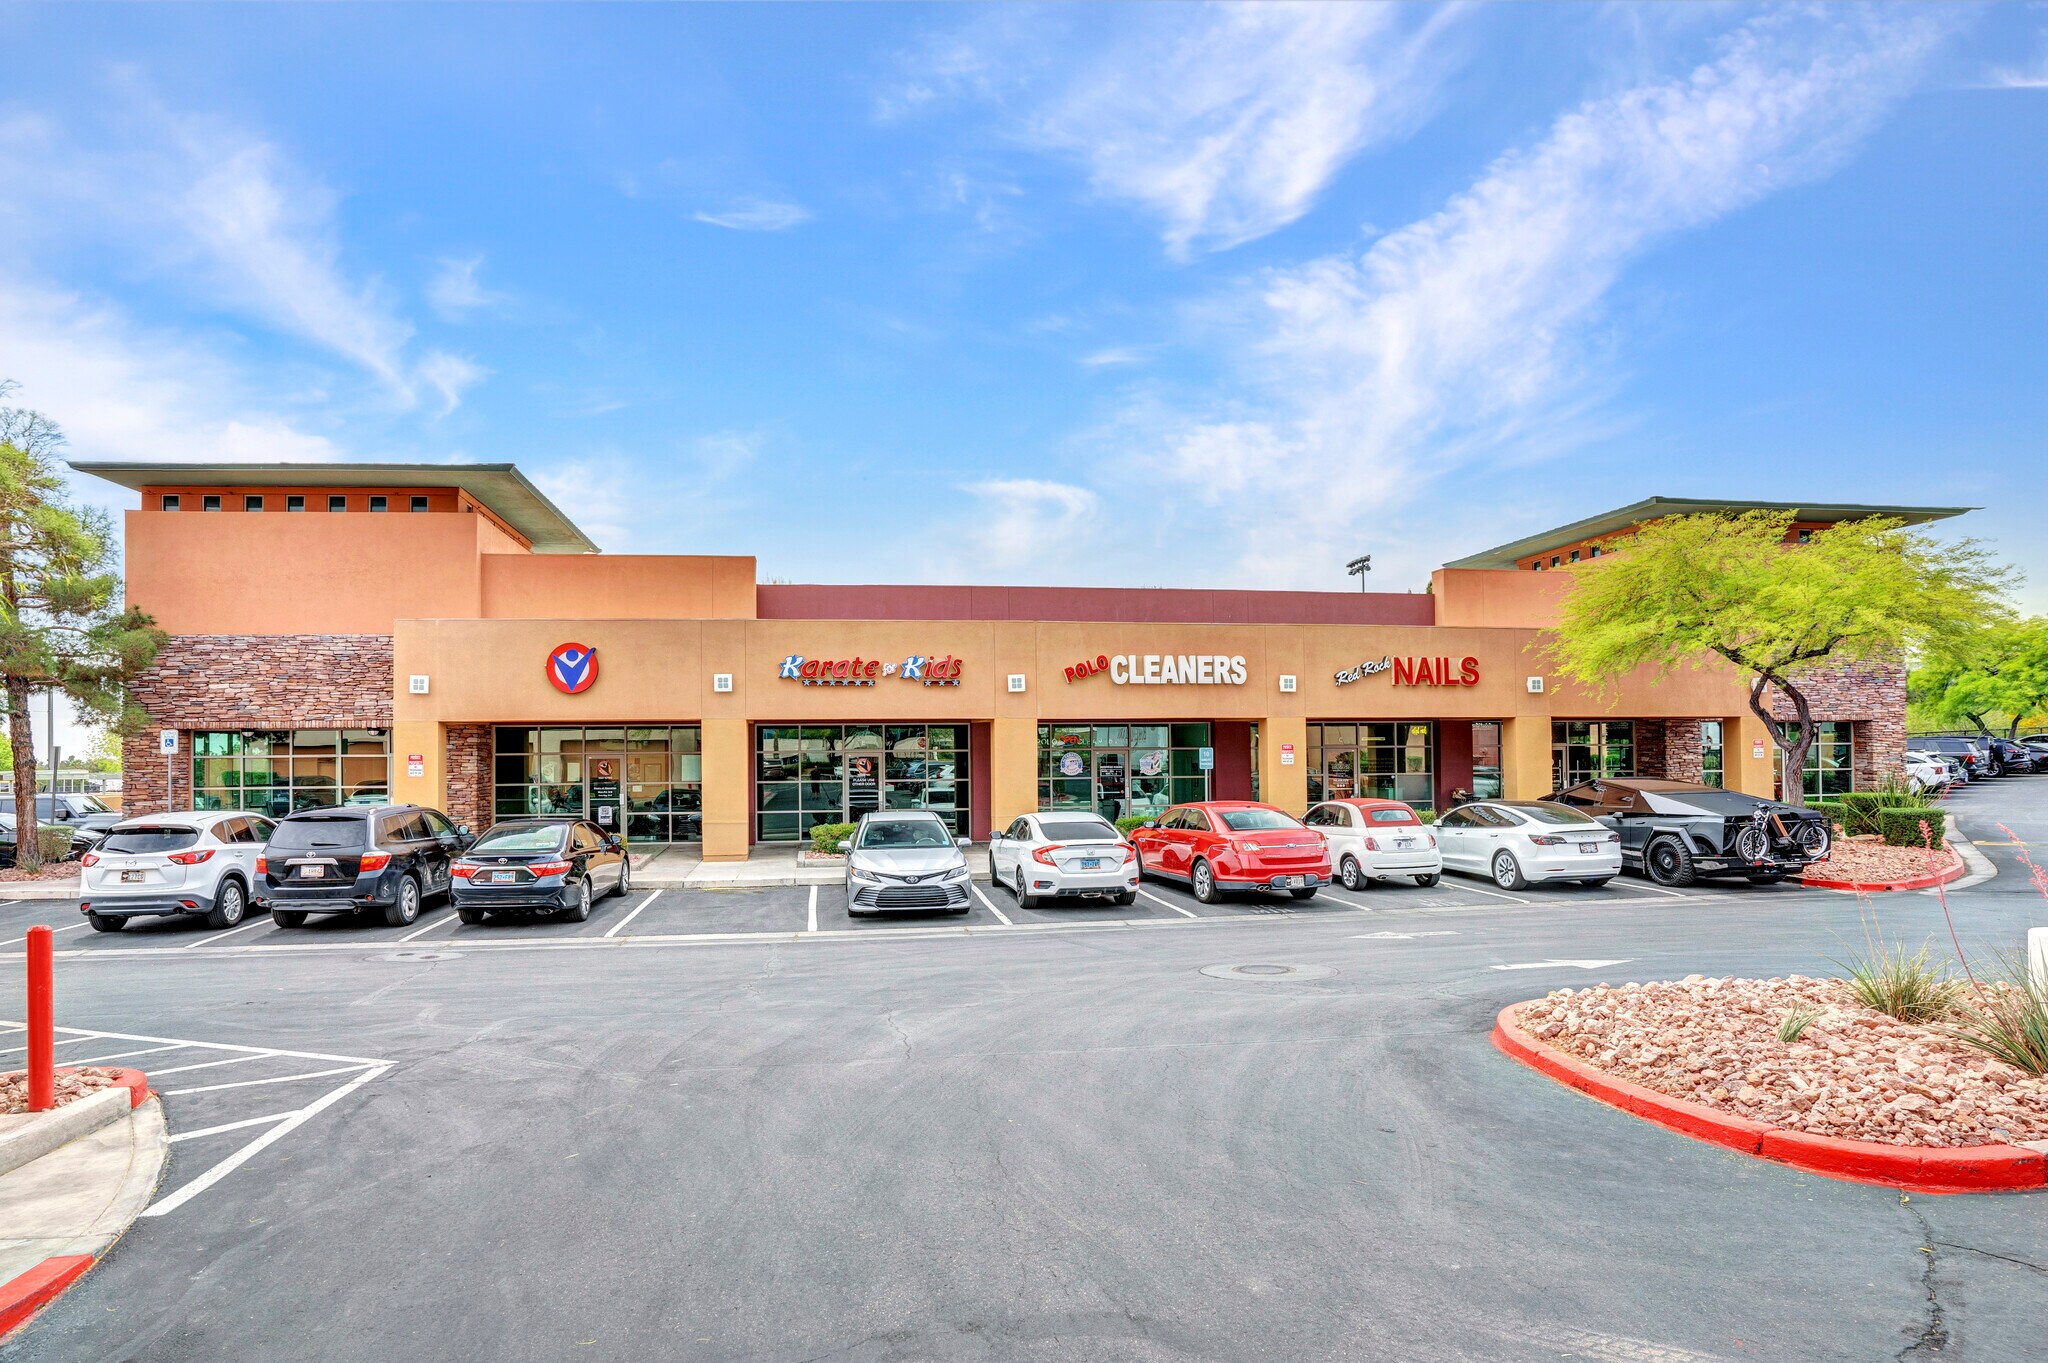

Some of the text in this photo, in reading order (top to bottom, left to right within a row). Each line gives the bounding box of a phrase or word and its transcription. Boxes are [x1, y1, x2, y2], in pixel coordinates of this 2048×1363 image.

[780, 655, 962, 680] Karate for Kids
[1063, 655, 1247, 685] POLO CLEANERS
[1335, 656, 1480, 687] Red Rock NAILS
[1058, 735, 1081, 744] OPEN
